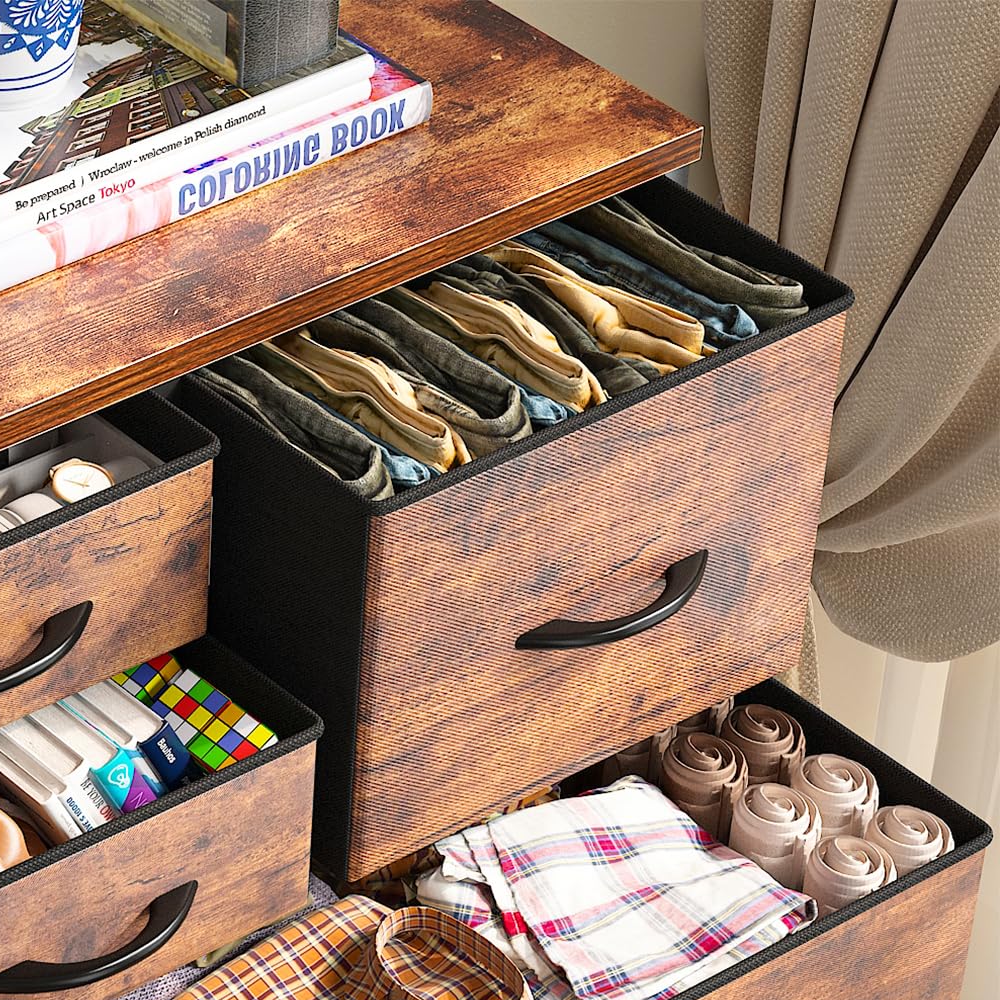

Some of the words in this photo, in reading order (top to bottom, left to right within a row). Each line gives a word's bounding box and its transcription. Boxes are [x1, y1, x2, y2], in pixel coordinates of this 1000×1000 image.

[15, 200, 28, 211] Be
[30, 180, 76, 207] prepared
[88, 159, 132, 182] Wroclaw
[138, 139, 182, 163] welcome
[183, 135, 193, 146] in
[194, 123, 223, 142] Polish
[224, 105, 266, 130] diamond
[37, 208, 58, 224] Art
[60, 194, 95, 215] Space
[98, 178, 135, 199] Tokyo
